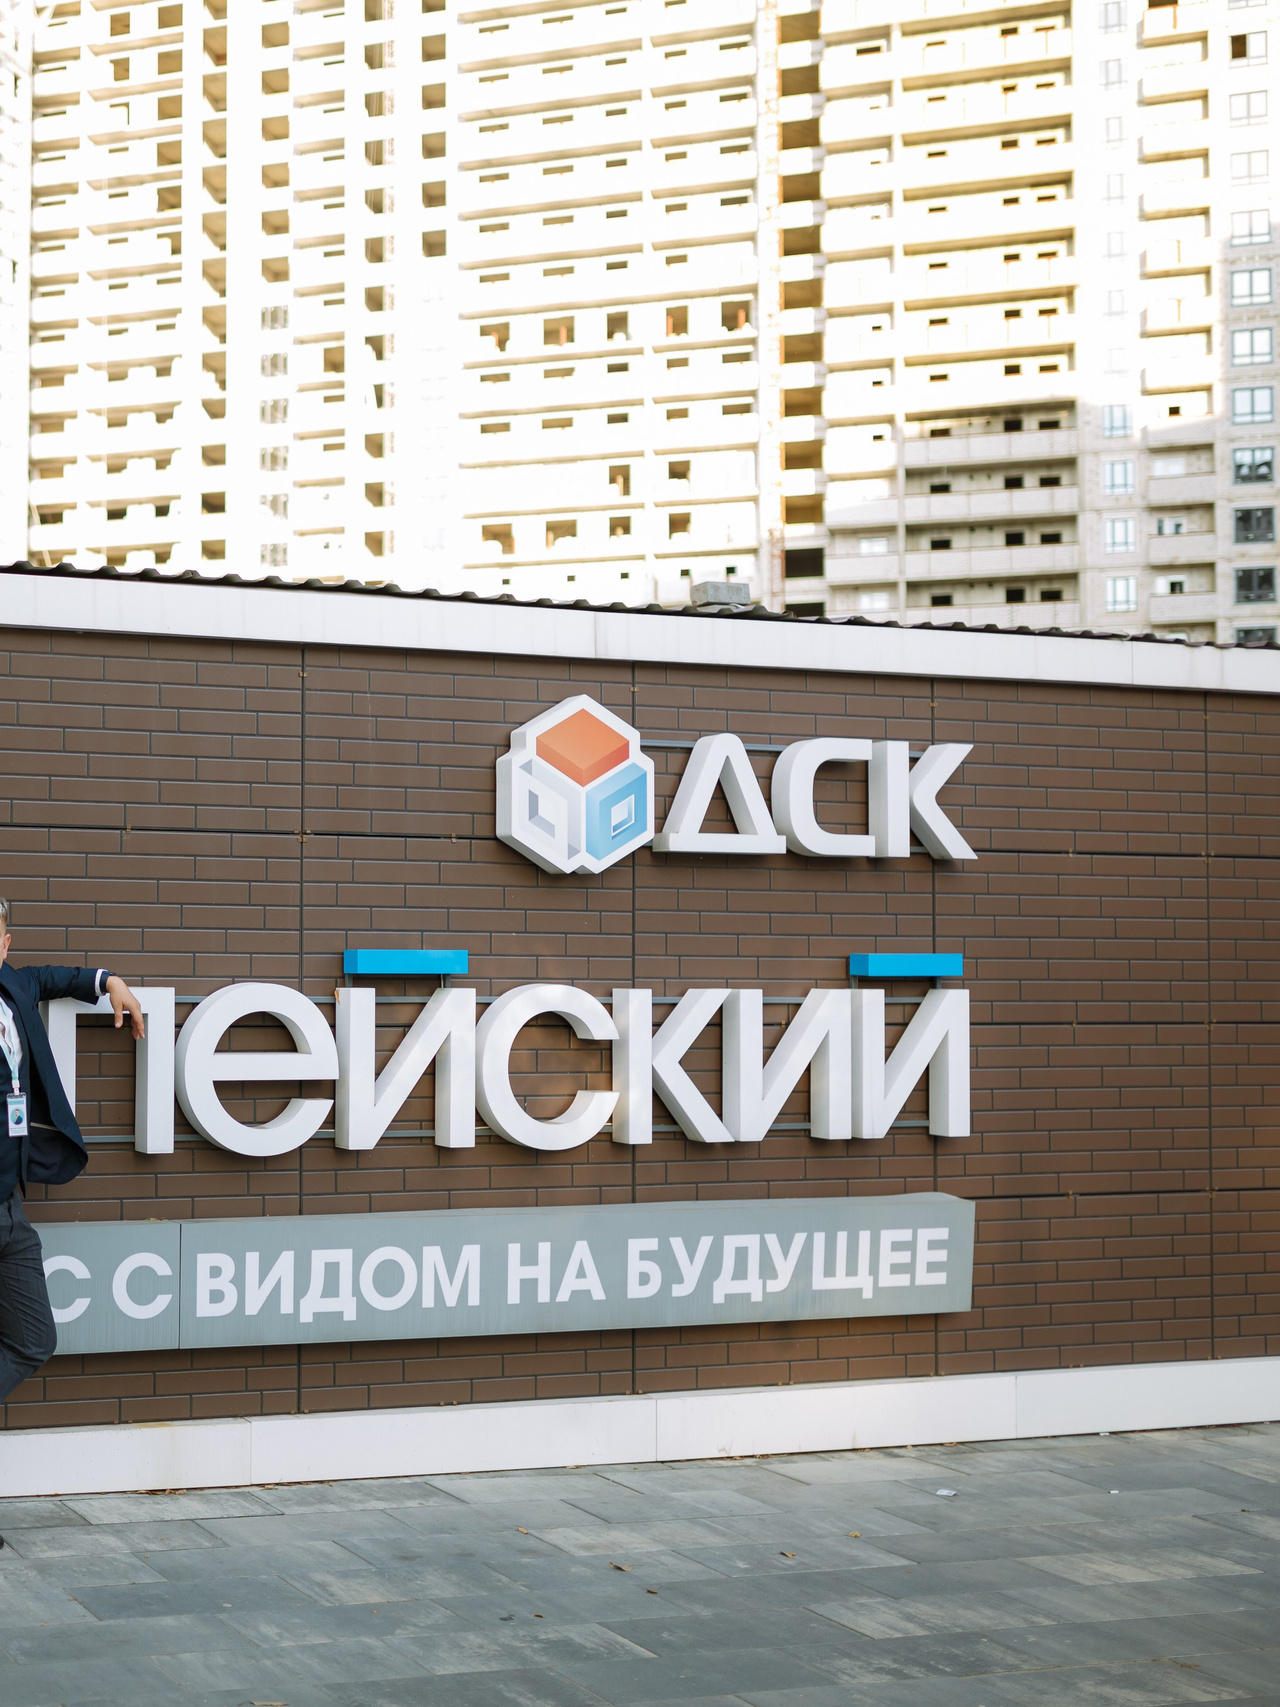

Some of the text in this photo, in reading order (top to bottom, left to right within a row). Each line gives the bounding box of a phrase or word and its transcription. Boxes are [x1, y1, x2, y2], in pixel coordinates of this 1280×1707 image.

[652, 732, 979, 860] ДСК
[112, 1252, 173, 1320] С
[195, 1244, 481, 1323] ВИДОМ
[508, 1240, 606, 1304] НА
[627, 1227, 950, 1304] БУДУЩЕЕ
